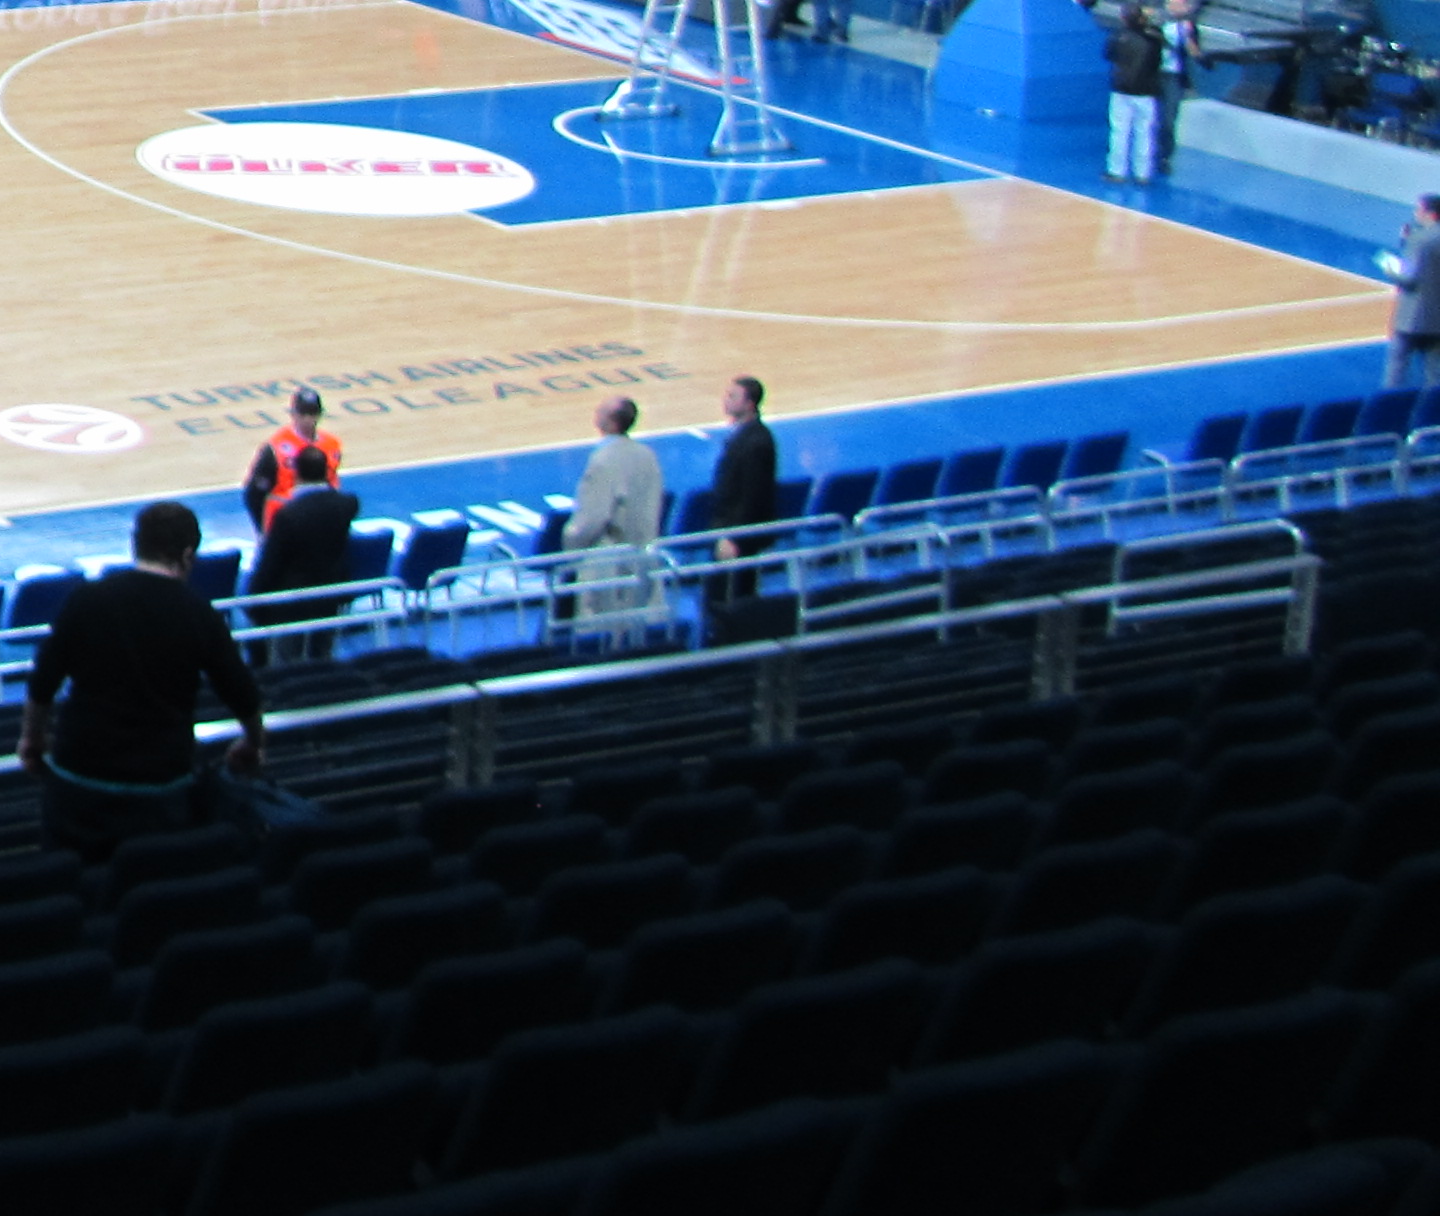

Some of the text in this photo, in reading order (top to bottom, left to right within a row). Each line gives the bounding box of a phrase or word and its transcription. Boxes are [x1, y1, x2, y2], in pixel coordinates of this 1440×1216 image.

[130, 339, 645, 412] TURKISH AIRLINES
[175, 360, 692, 438] EUOLEAGUE
